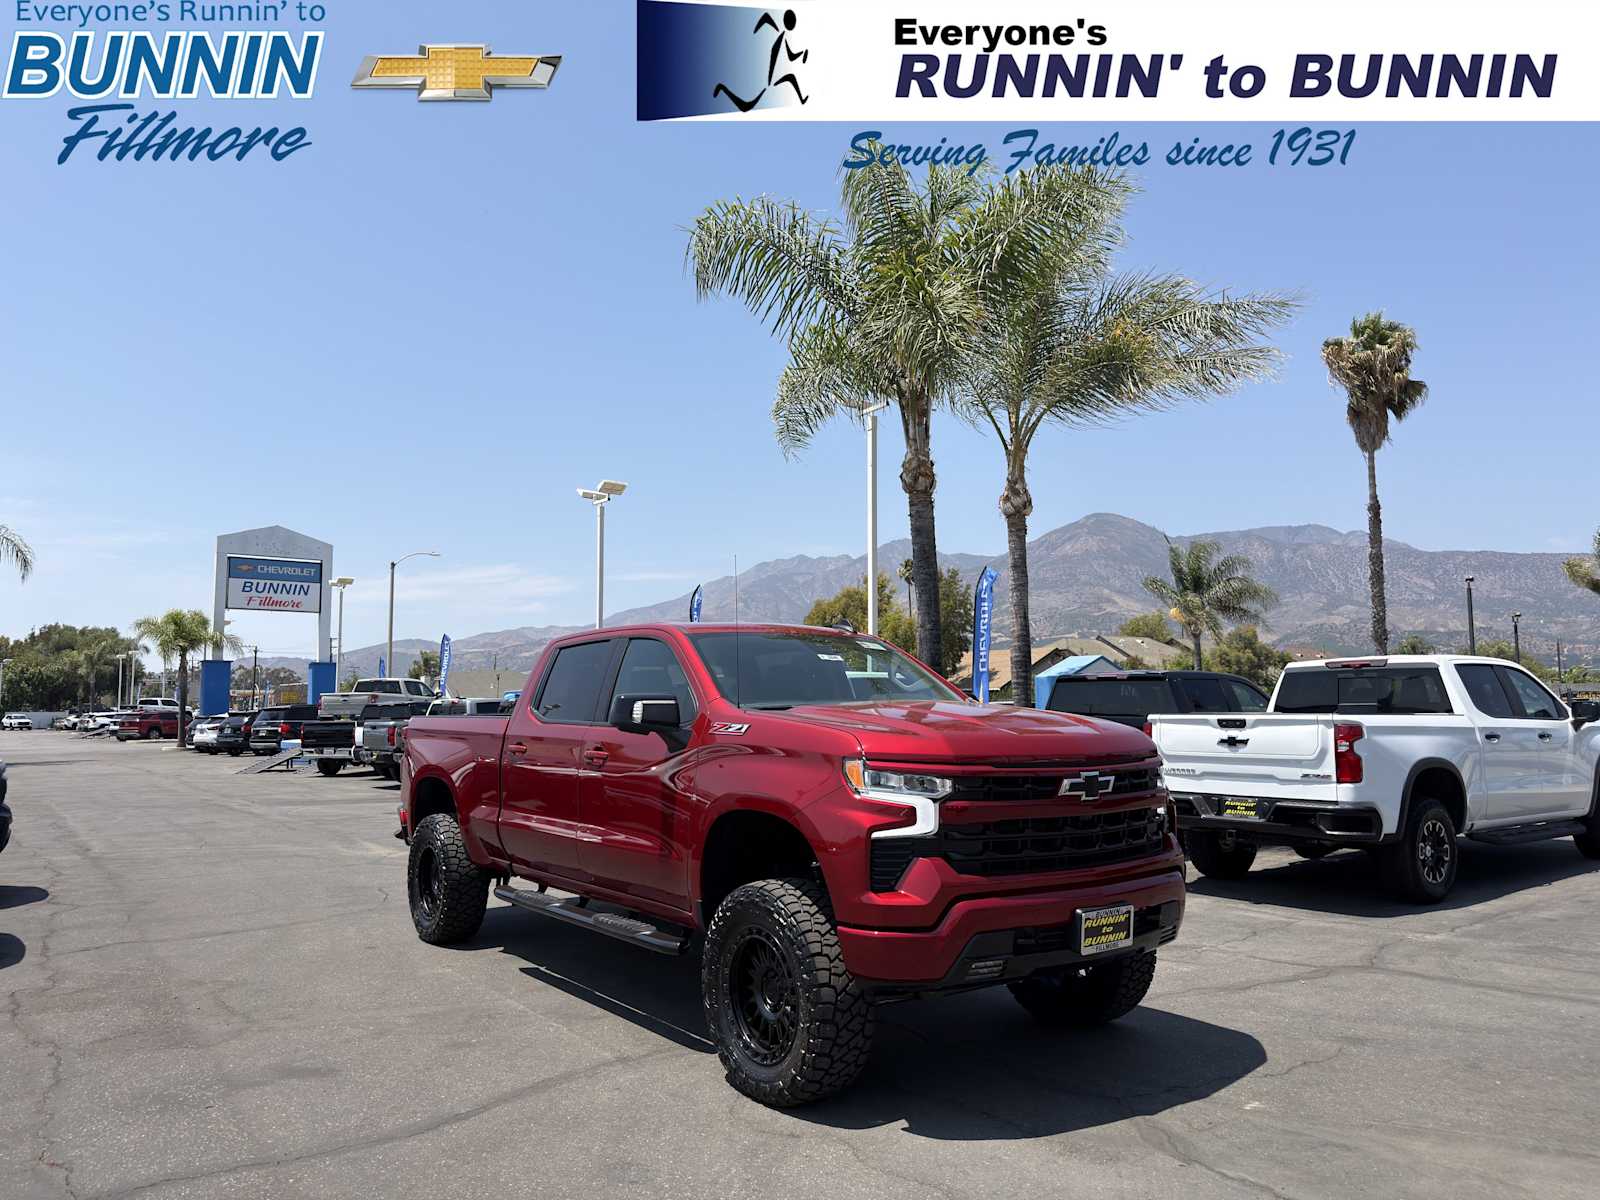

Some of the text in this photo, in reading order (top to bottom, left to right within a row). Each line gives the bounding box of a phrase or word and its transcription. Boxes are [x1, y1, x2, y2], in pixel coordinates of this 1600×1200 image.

[257, 564, 316, 577] CHEVROLET
[241, 581, 311, 596] BUNNIN
[246, 596, 303, 609] Fillmore
[979, 578, 989, 672] CHEVROLET
[1083, 931, 1127, 947] BUNNIN
